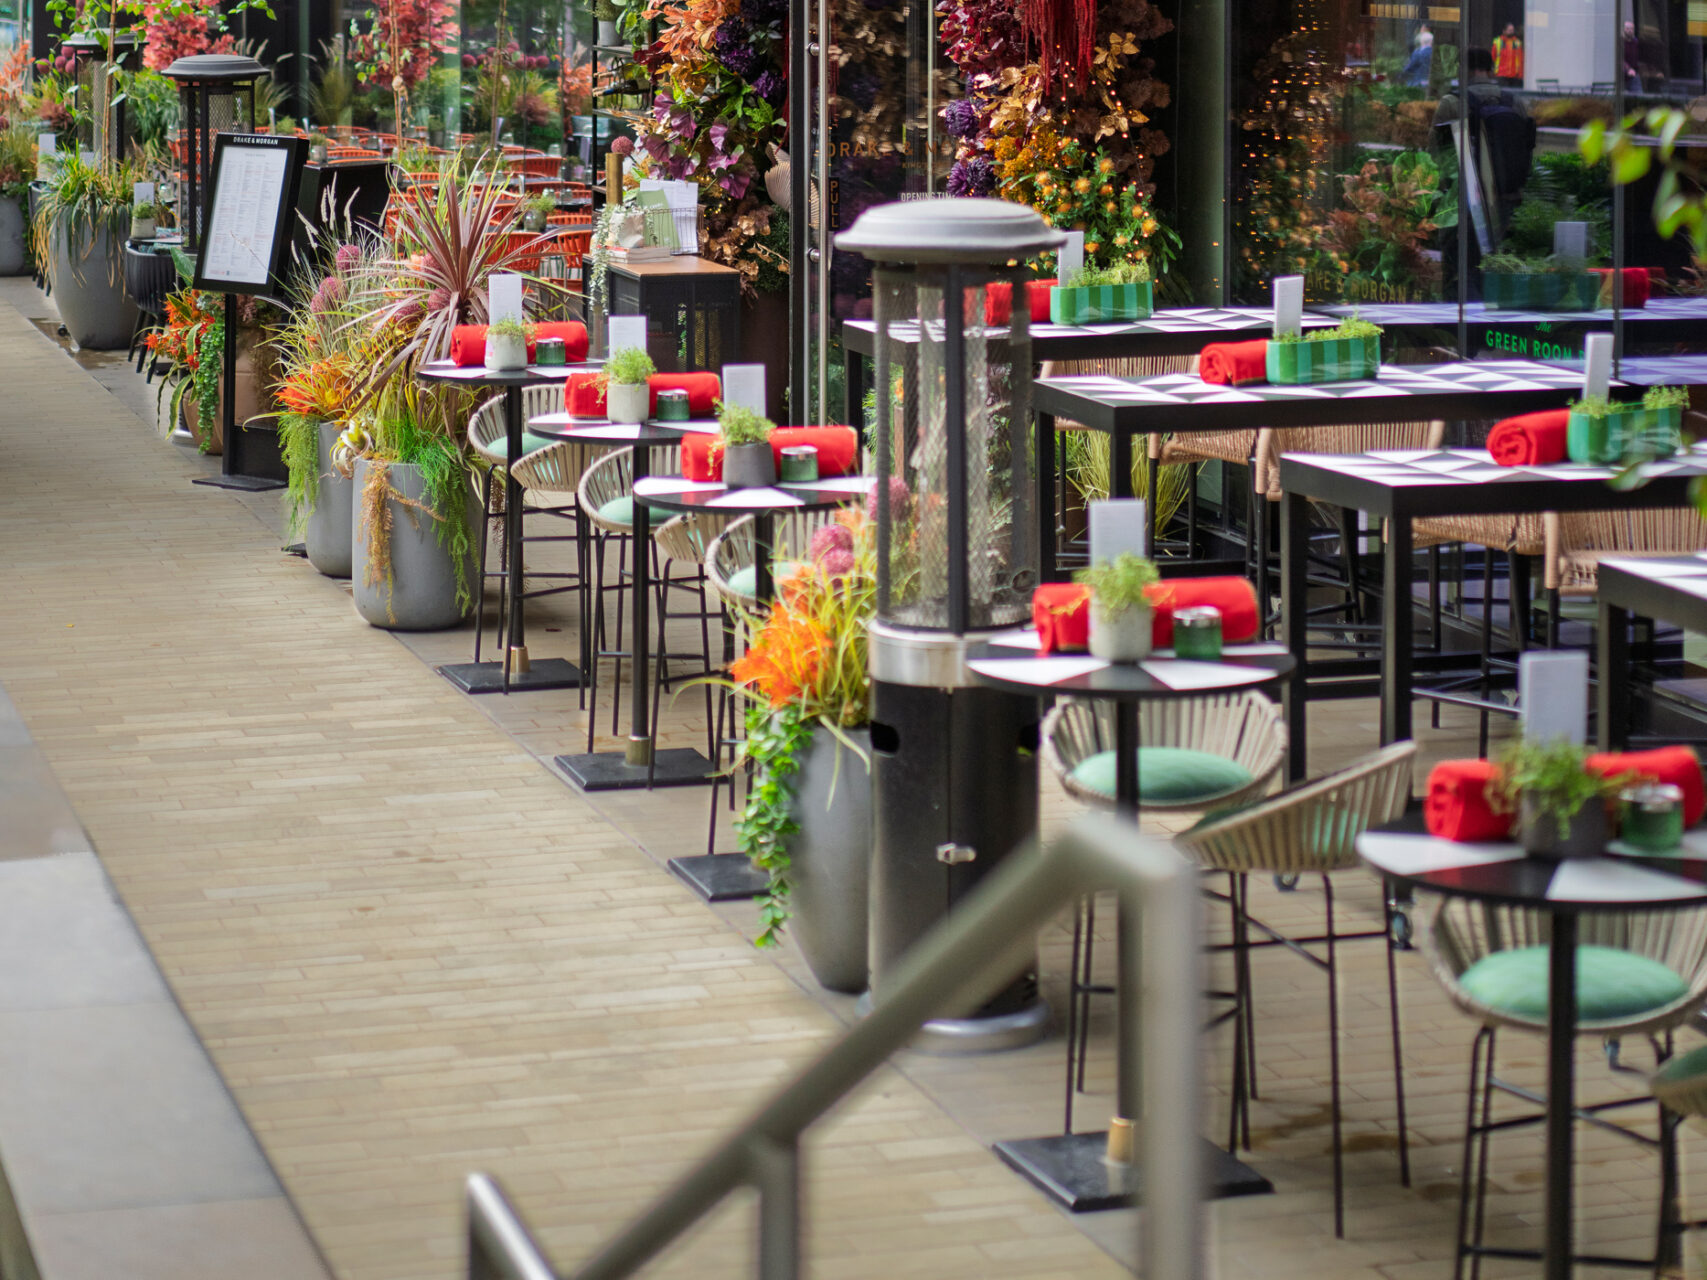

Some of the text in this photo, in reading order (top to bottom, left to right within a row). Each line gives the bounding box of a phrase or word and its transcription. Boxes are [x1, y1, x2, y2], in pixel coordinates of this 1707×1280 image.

[233, 136, 251, 144] DRAKE
[830, 180, 839, 228] PULL
[1485, 329, 1528, 355] GREEN
[1533, 339, 1573, 360] ROOM
